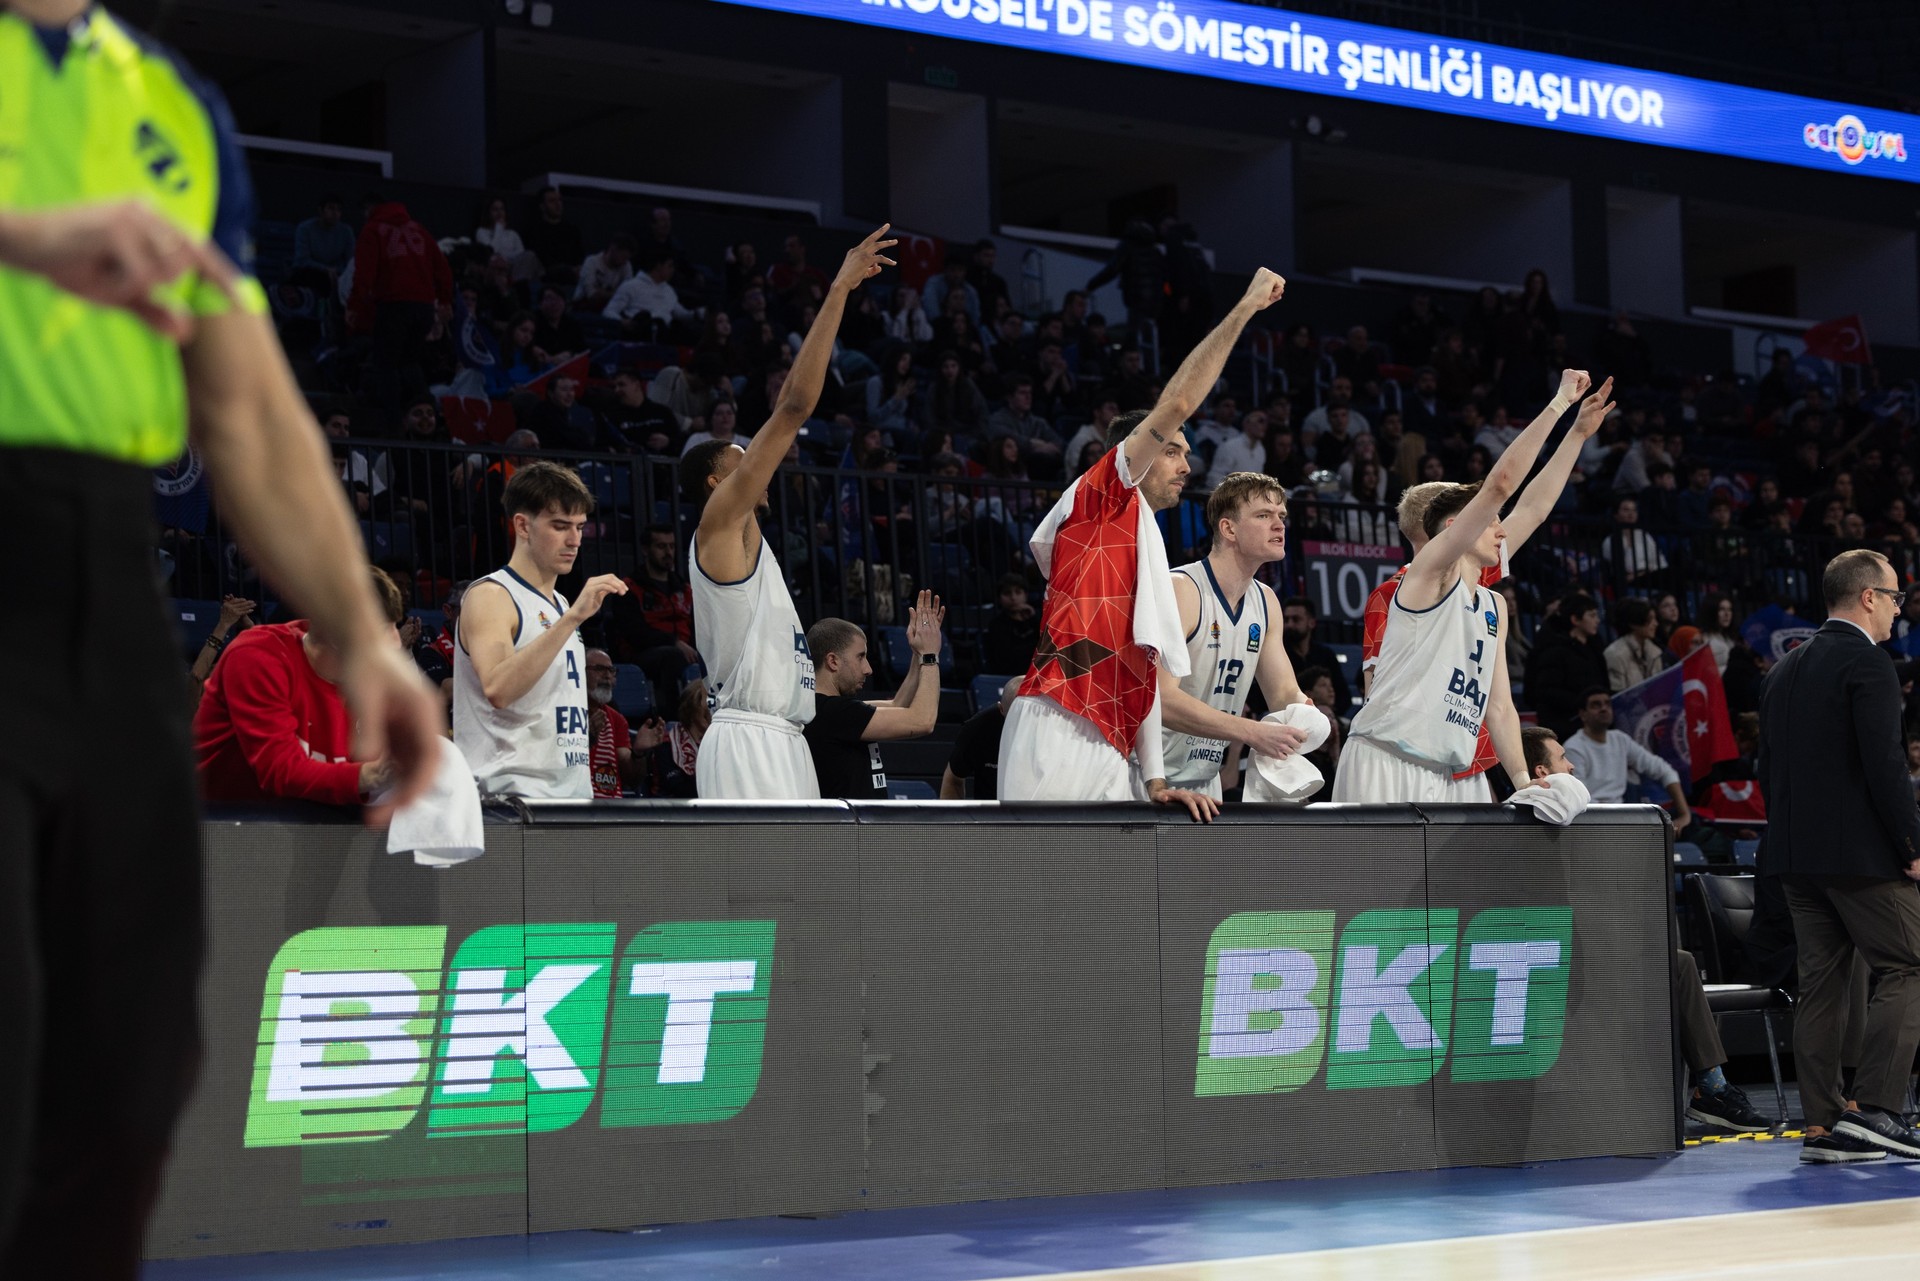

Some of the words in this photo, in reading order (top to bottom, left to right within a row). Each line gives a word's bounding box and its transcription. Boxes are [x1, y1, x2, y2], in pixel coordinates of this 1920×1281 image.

[861, 0, 1113, 42] USEL'DE
[1123, 1, 1330, 76] SÖMESTİR
[1337, 40, 1483, 98] ŞENLİĞİ
[1491, 65, 1664, 128] BAŞLIYOR
[1321, 543, 1348, 556] BLOK
[1353, 545, 1387, 559] BLOCK
[1214, 659, 1244, 695] 12
[595, 772, 617, 785] BAXI
[265, 960, 758, 1102] BKT
[1207, 940, 1561, 1060] BKT
